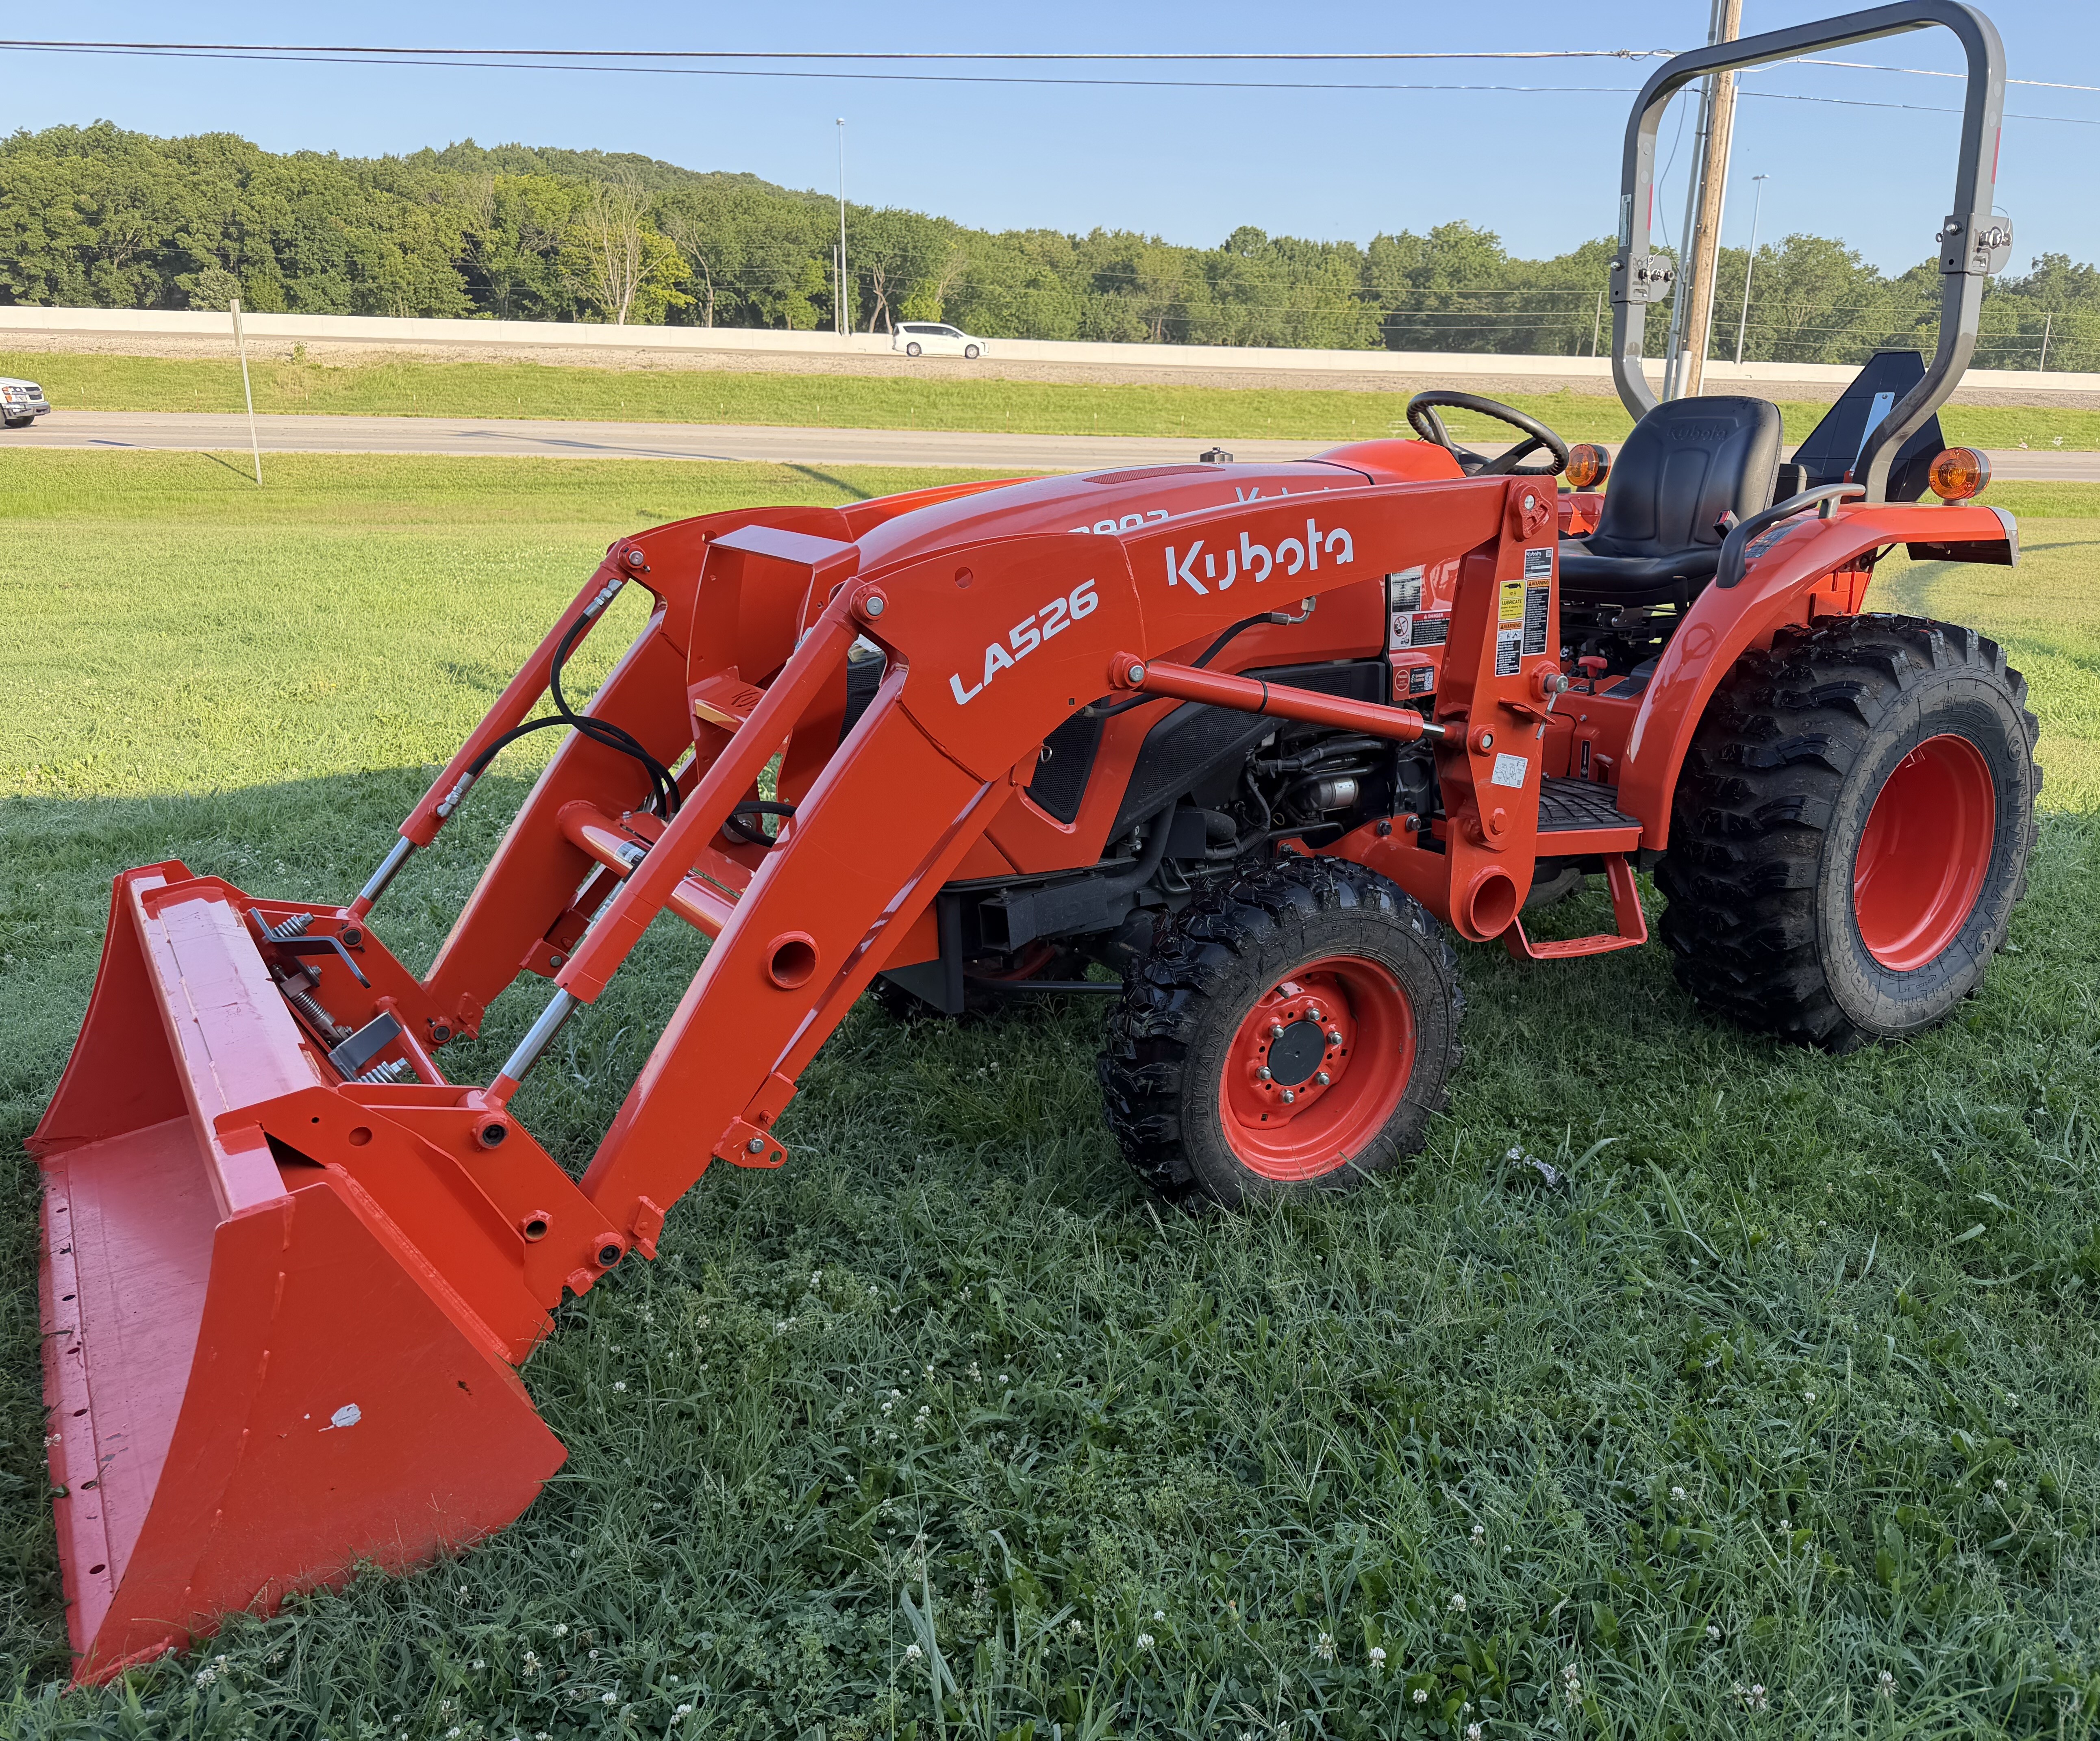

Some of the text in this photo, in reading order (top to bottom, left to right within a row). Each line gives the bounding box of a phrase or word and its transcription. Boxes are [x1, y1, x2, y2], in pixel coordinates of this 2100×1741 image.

[1667, 425, 1727, 441] Kubota
[1165, 518, 1354, 595] Kubota
[949, 578, 1098, 705] LA526
[1985, 768, 2028, 931] TITAN
[1191, 1023, 1225, 1124] TITAN
